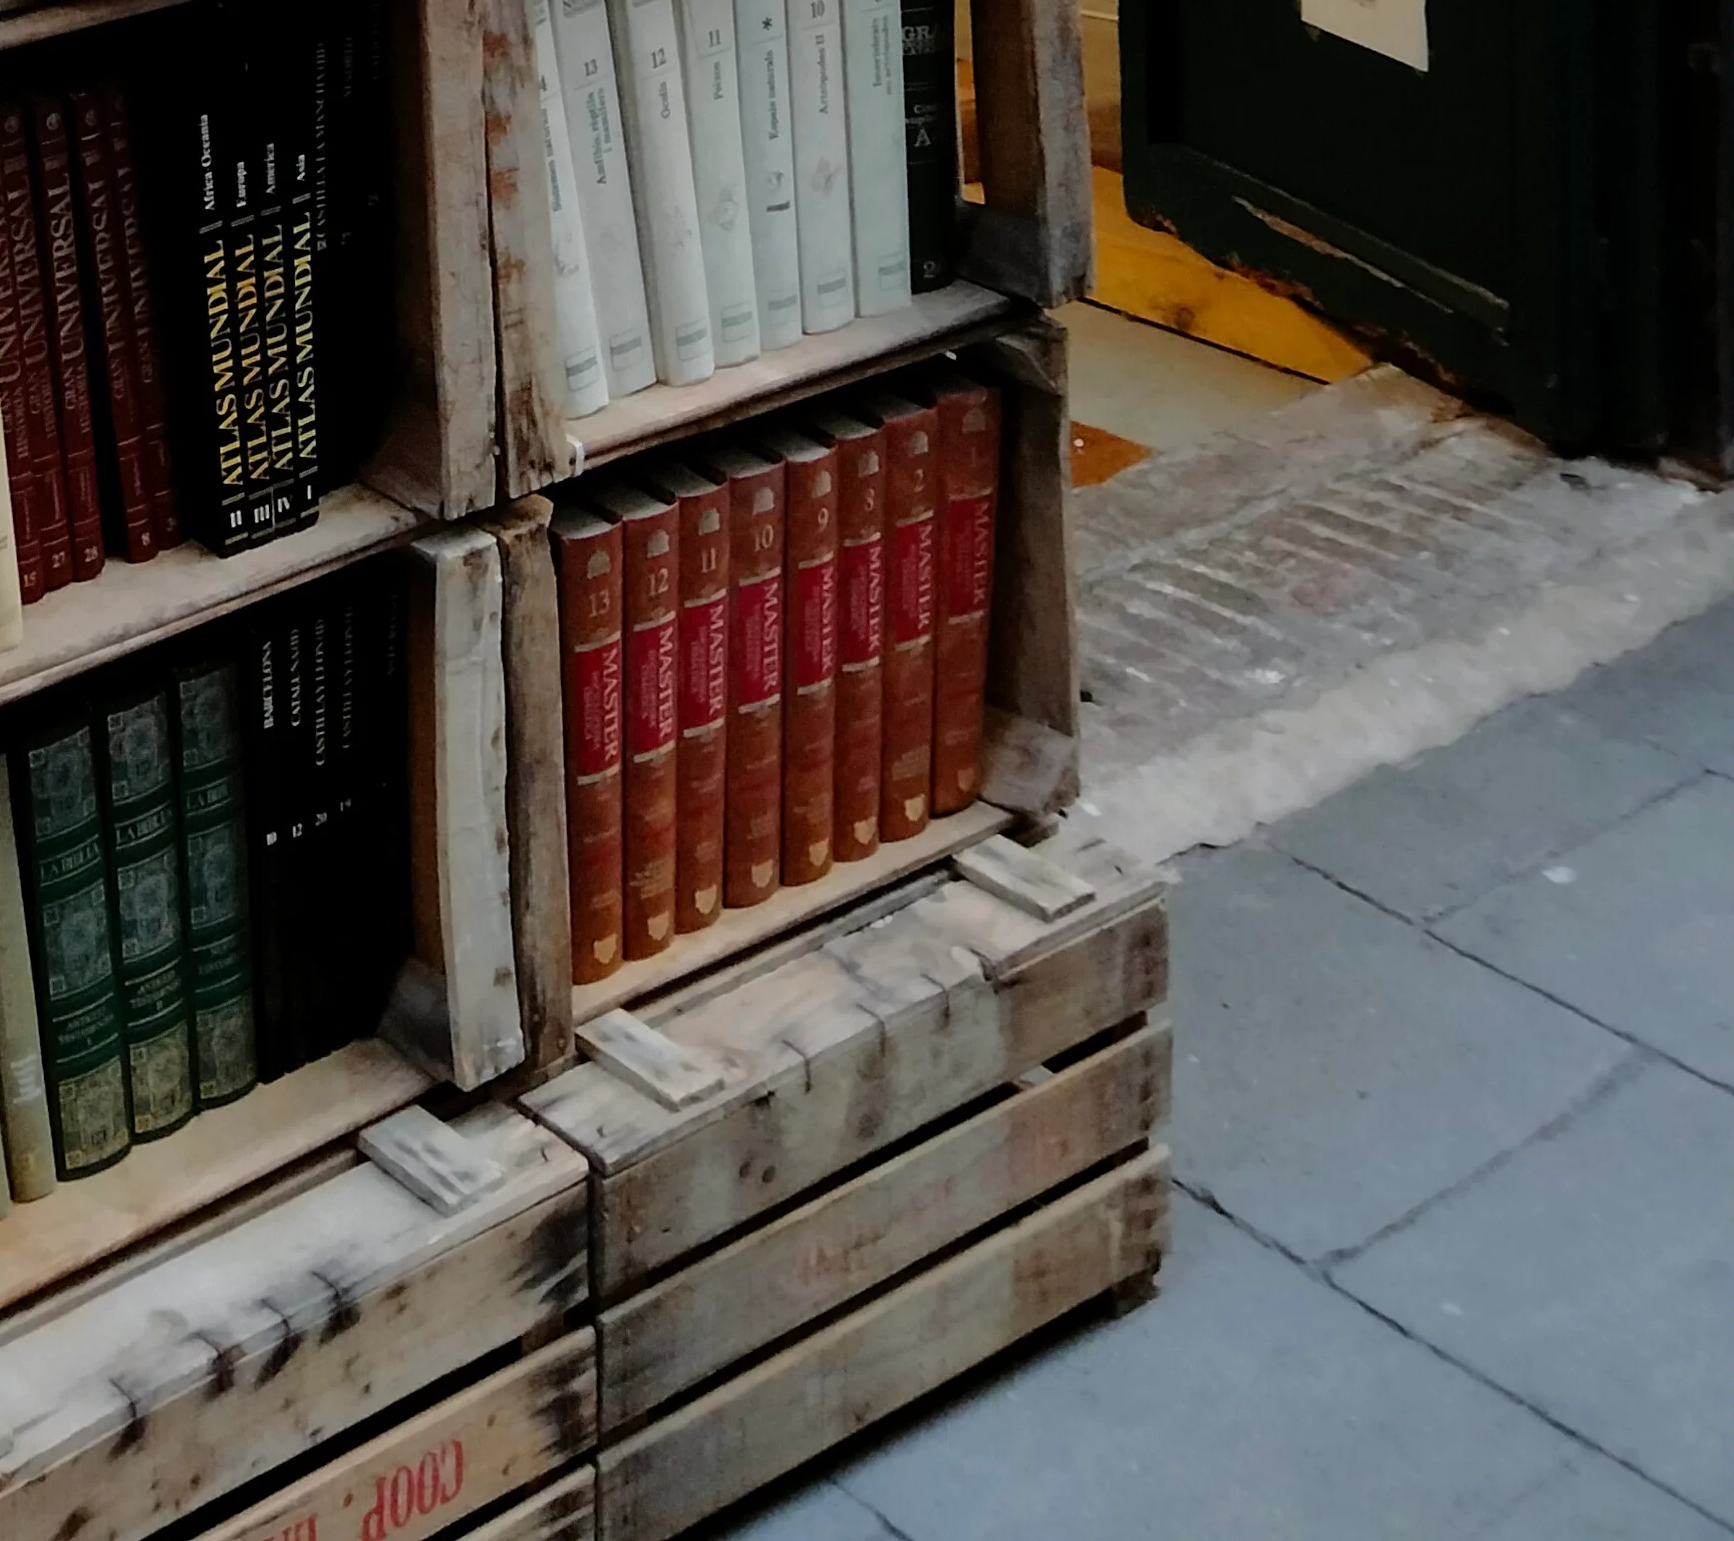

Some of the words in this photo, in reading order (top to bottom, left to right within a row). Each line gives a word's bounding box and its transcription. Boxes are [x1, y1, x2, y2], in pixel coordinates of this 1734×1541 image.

[708, 29, 721, 49] 11
[810, 0, 825, 18] 10
[584, 59, 598, 77] 13
[650, 47, 667, 69] 12
[296, 154, 306, 183] Asia
[914, 127, 931, 147] A
[236, 161, 247, 208] Europa
[7, 175, 48, 365] UNIVERSAL
[47, 172, 84, 361] UNIVERSAL
[233, 234, 264, 386] MUNDIAL
[263, 224, 289, 377] MUNDIAL
[291, 212, 314, 363] MUNDIAL
[204, 240, 234, 392] MUNDIAL
[216, 393, 242, 486] ATLAS
[244, 390, 269, 482] ATLAS
[268, 379, 294, 472] ATLAS
[296, 366, 317, 459] ATLAS
[754, 524, 774, 552] 10
[818, 507, 829, 533] 9
[866, 488, 875, 511] 8
[23, 571, 37, 589] 15
[701, 547, 716, 574] 11
[869, 545, 882, 652] MASTER
[917, 524, 932, 630] MASTER
[973, 502, 989, 604] MASTER
[589, 589, 611, 618] 13
[763, 582, 779, 693] MASTER
[821, 566, 834, 674] MASTER
[602, 648, 618, 761] MASTER
[658, 626, 675, 742] MASTER
[708, 604, 725, 715] MASTER
